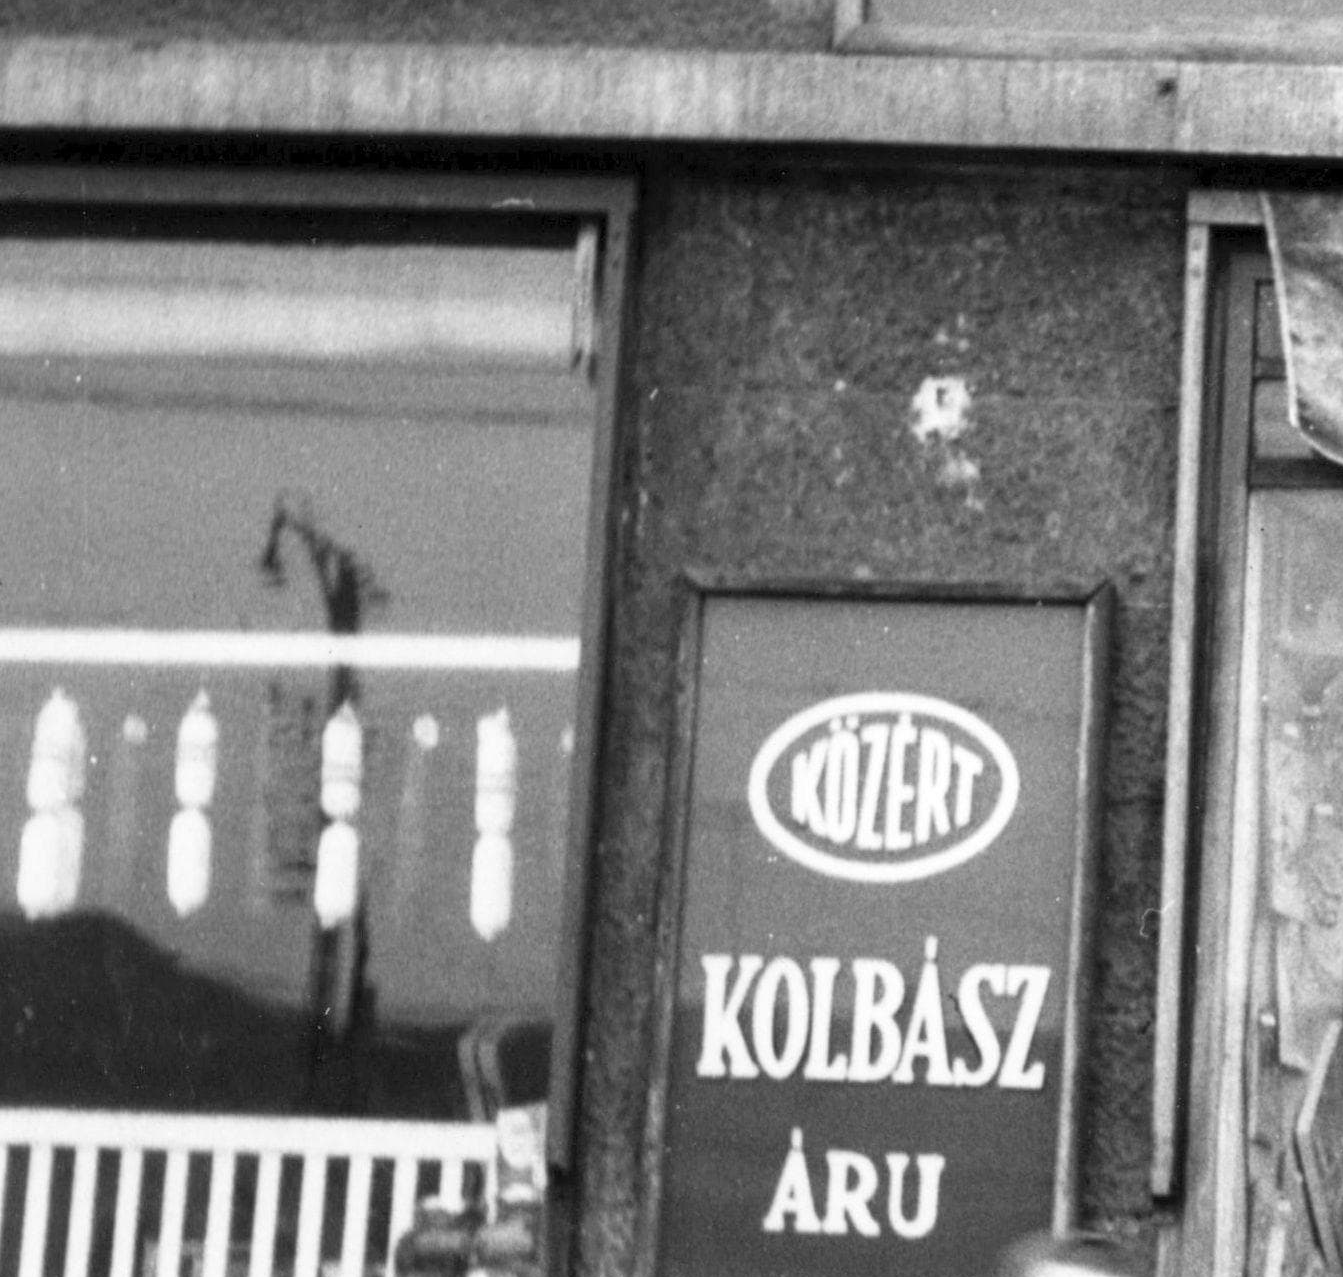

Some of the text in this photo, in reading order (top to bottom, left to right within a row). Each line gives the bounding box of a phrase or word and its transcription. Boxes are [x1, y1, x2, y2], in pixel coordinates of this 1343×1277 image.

[790, 711, 984, 851] KÖZÉRT
[696, 934, 1052, 1090] KOLBÁSZ
[762, 1126, 946, 1239] ÁRU
